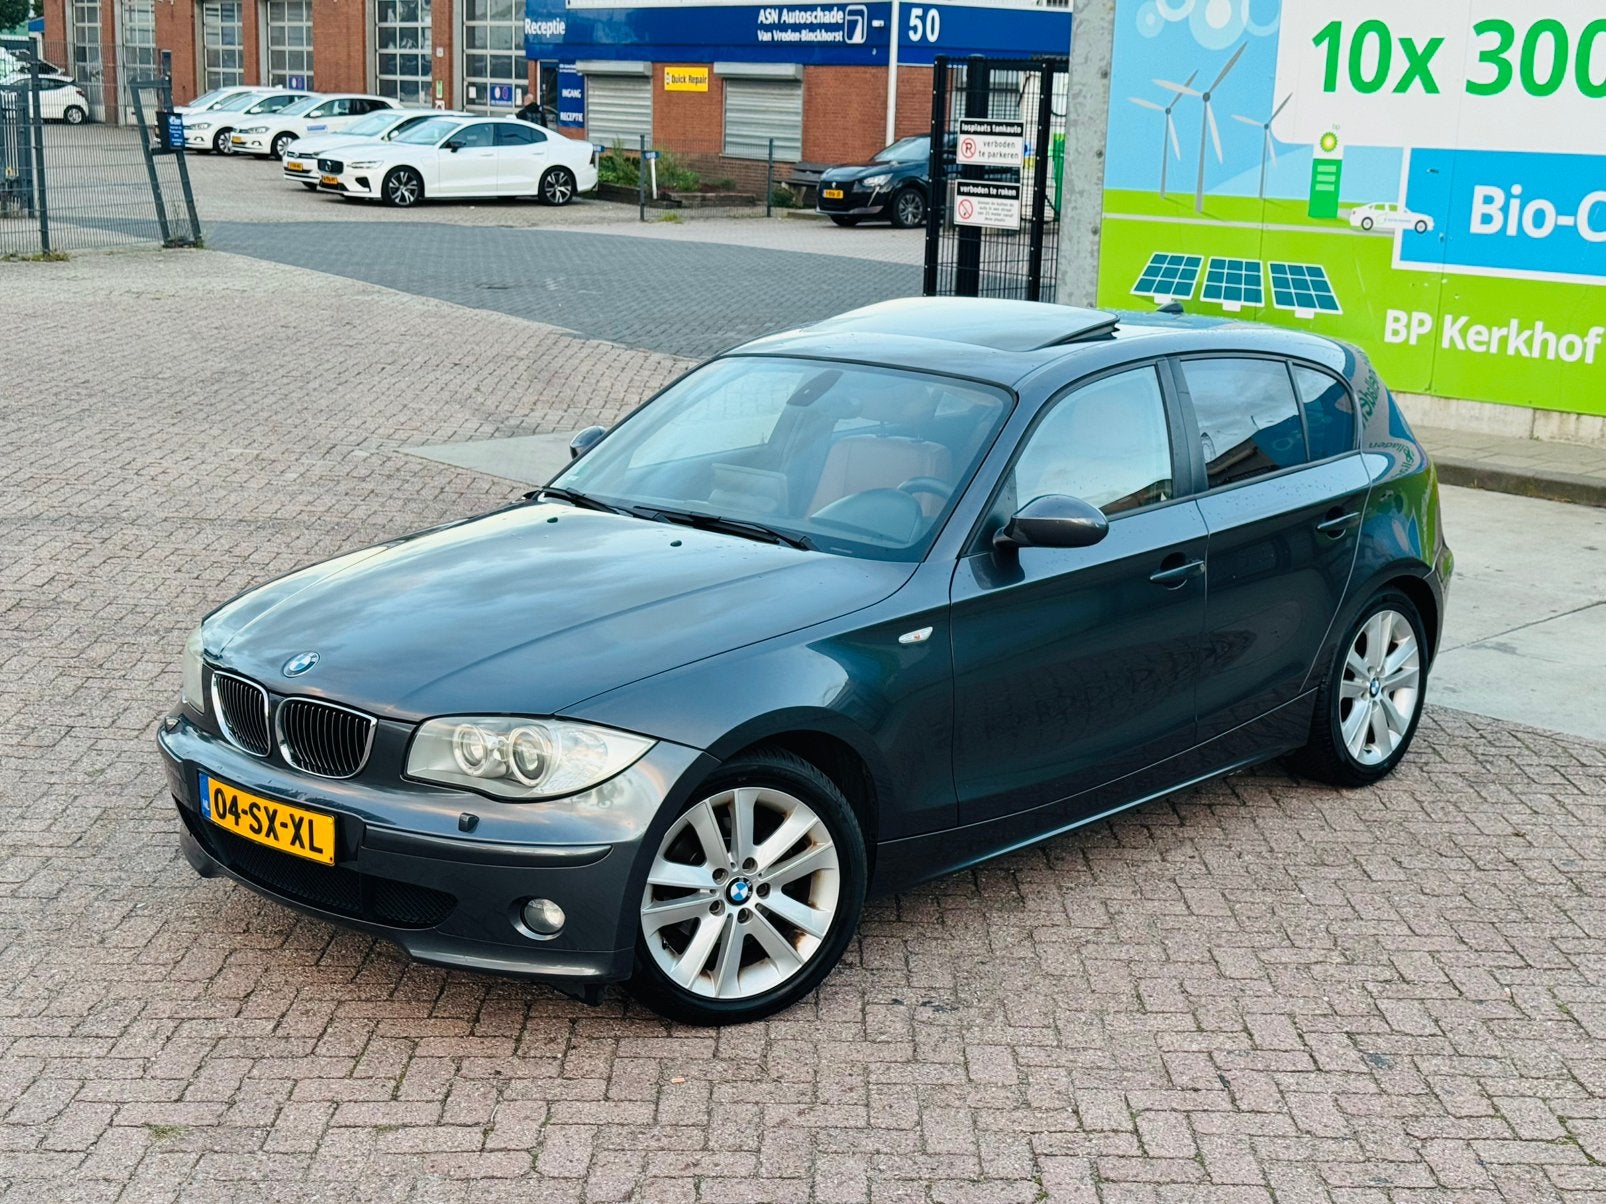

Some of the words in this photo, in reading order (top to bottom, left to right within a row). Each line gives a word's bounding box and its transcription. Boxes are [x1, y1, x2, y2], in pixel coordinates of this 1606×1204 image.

[758, 8, 778, 24] ASN
[781, 7, 844, 24] Autoschade
[524, 17, 566, 38] Receptie
[908, 8, 941, 43] 50
[757, 30, 772, 42] Van
[773, 29, 844, 42] Vreden-Binckhorst
[1312, 19, 1445, 94] 10x
[1465, 18, 1606, 98] 300
[672, 74, 686, 84] Quick
[688, 74, 707, 86] Repair
[961, 123, 991, 133] losplaats
[992, 124, 1022, 134] tankauto
[983, 140, 1016, 149] verboden
[978, 150, 985, 158] te
[987, 151, 1019, 160] parkeren
[960, 185, 989, 195] verboden
[990, 186, 997, 196] te
[998, 187, 1017, 197] roken
[1384, 309, 1433, 346] BP
[1441, 314, 1605, 365] Kerkhof
[213, 787, 324, 855] 04-SX-XL
